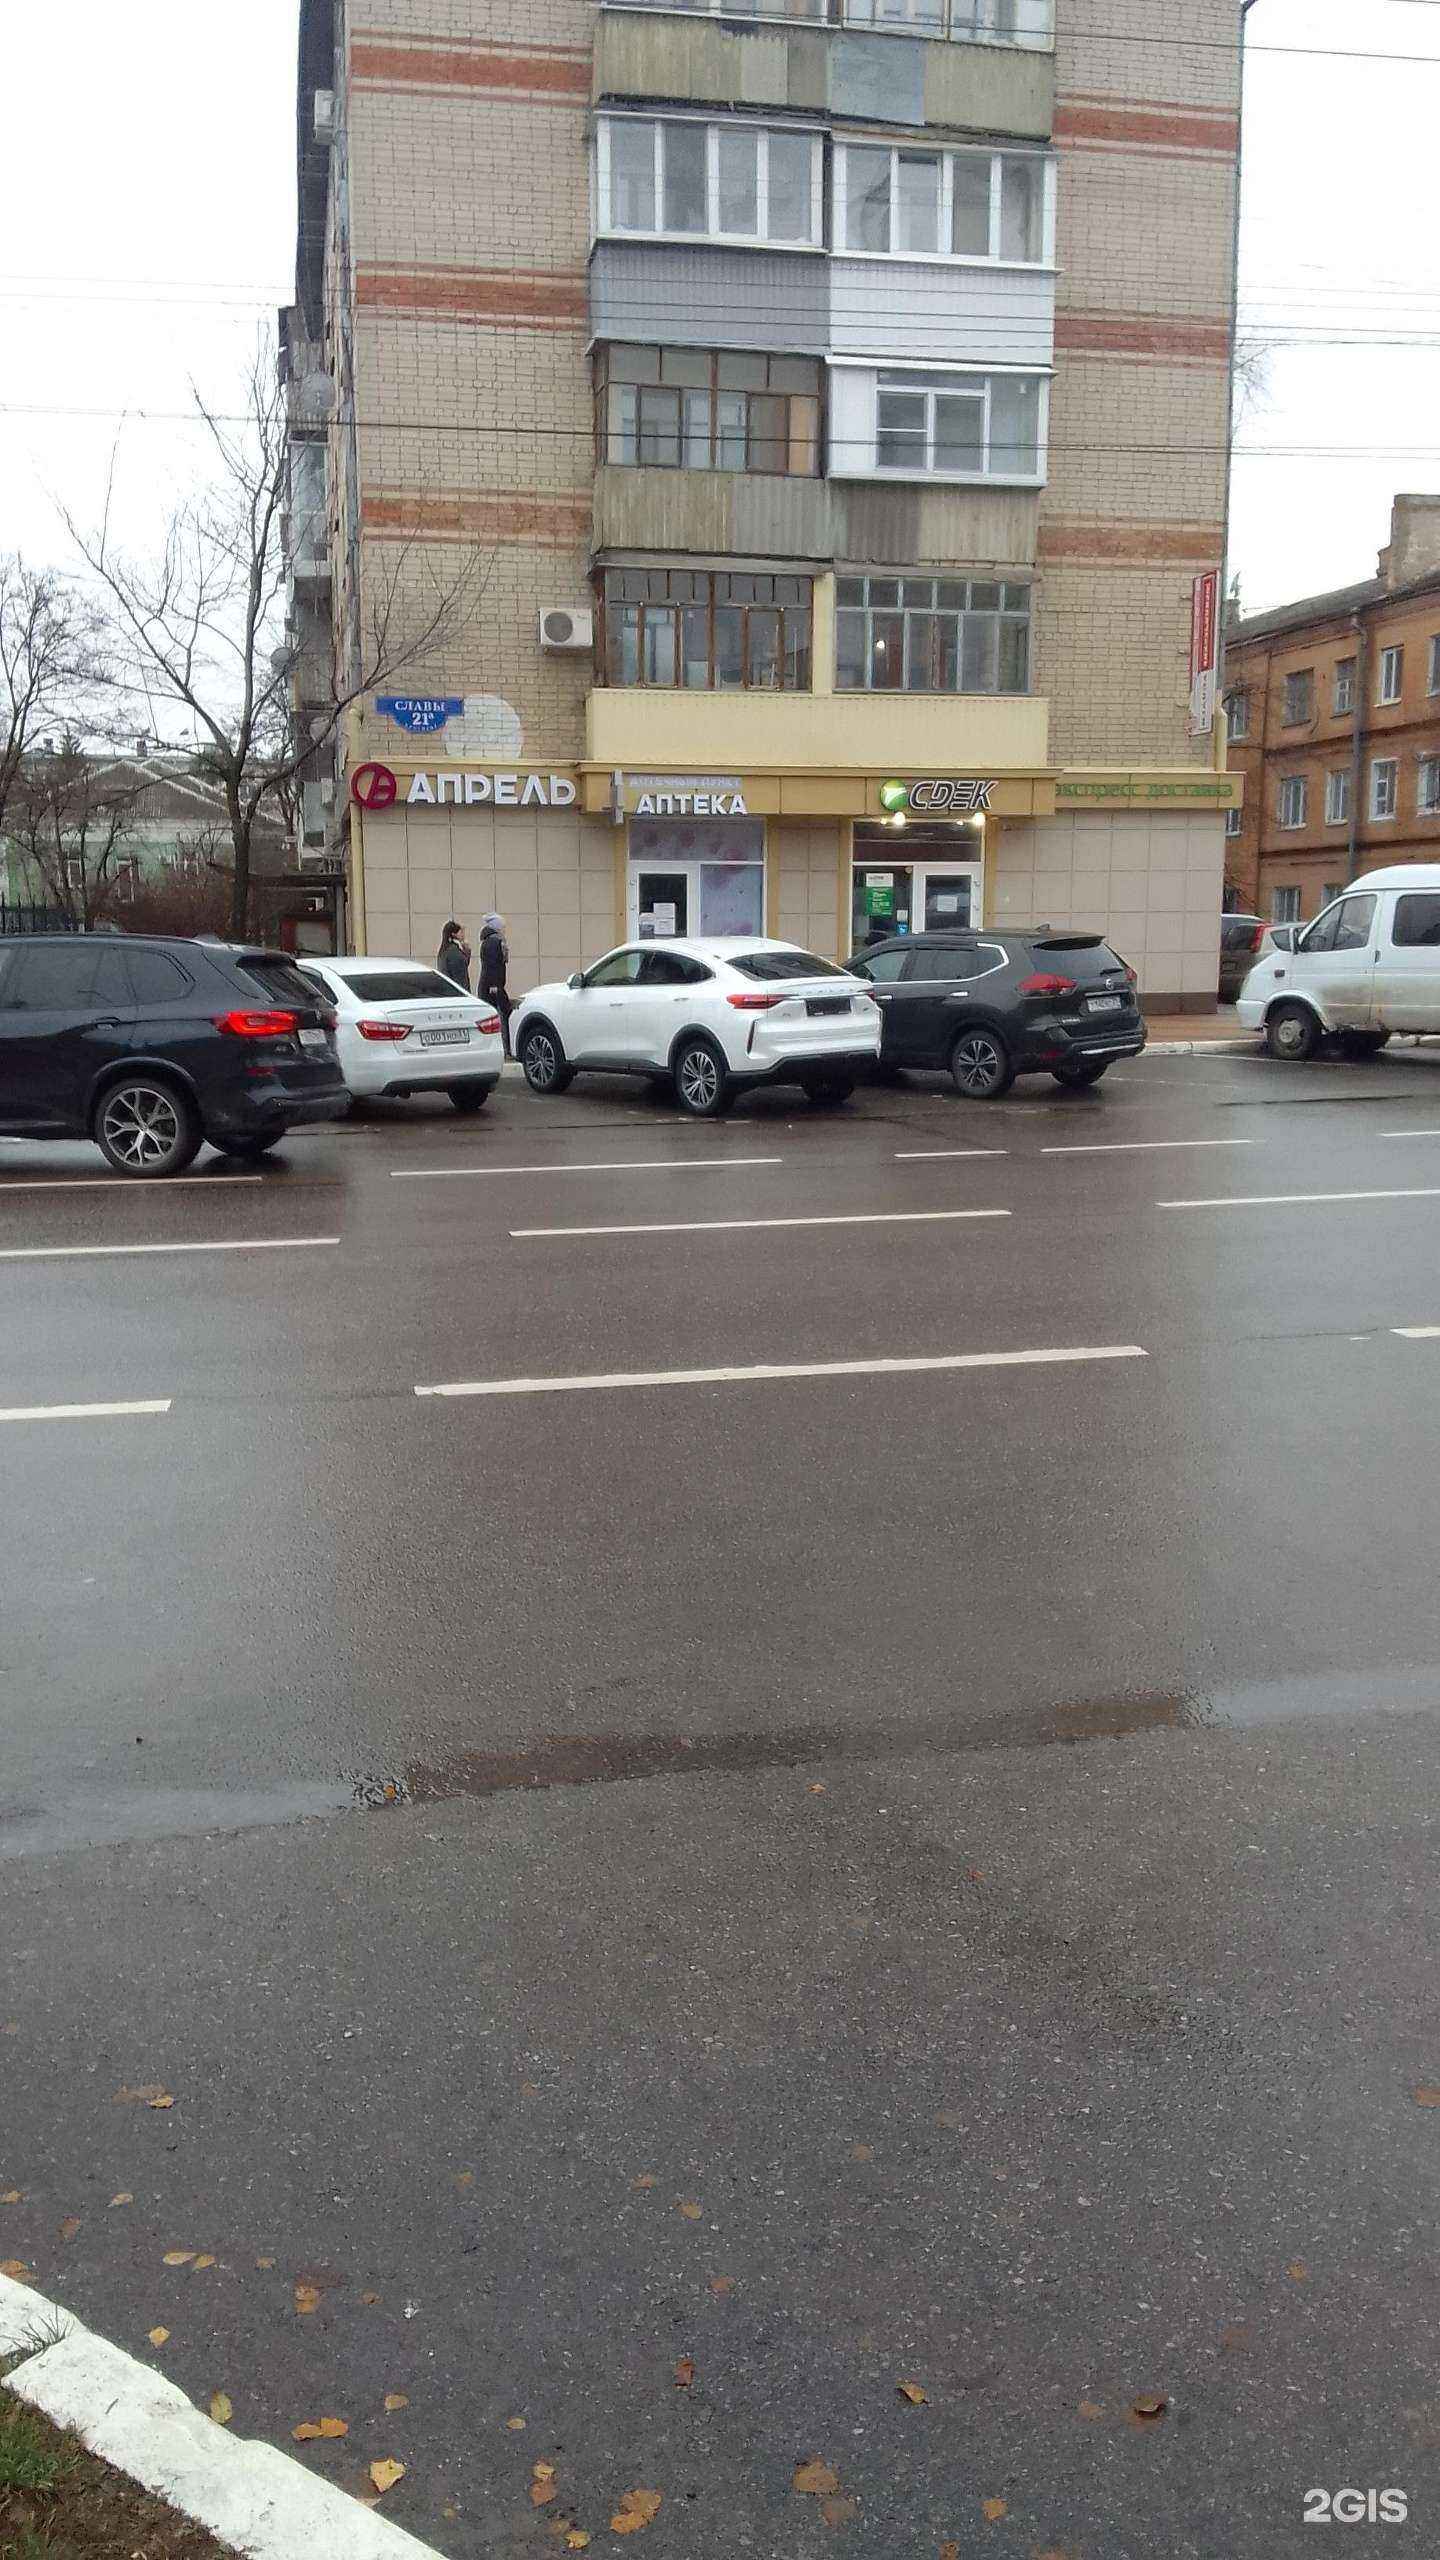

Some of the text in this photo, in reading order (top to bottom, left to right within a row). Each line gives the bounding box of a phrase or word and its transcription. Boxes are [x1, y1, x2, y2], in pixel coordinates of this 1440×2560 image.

[394, 700, 446, 712] СЛАВЫ
[407, 773, 576, 805] АПРЕЛЬ
[637, 793, 748, 815] АПТЕКА
